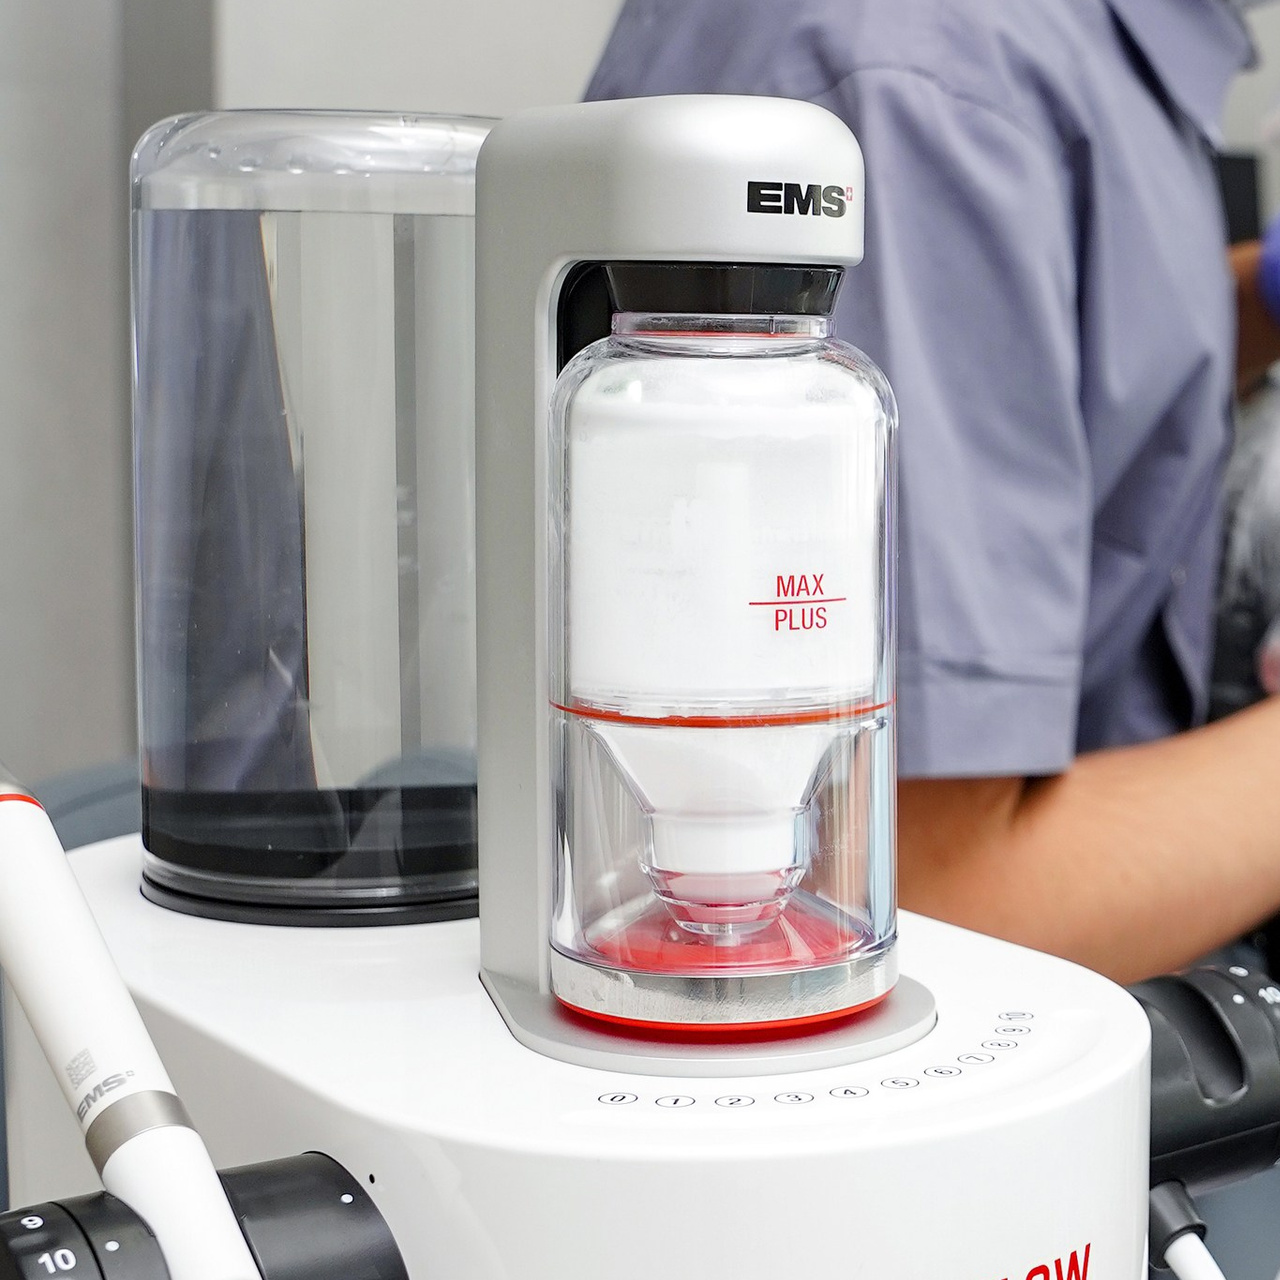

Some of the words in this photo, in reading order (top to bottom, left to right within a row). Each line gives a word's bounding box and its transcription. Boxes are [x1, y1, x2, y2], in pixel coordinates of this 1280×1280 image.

[747, 181, 847, 218] EMS
[776, 573, 824, 597] MAX
[774, 606, 827, 631] PLUS
[76, 1072, 127, 1124] EMS
[20, 1215, 44, 1230] 9
[37, 1248, 77, 1274] 10
